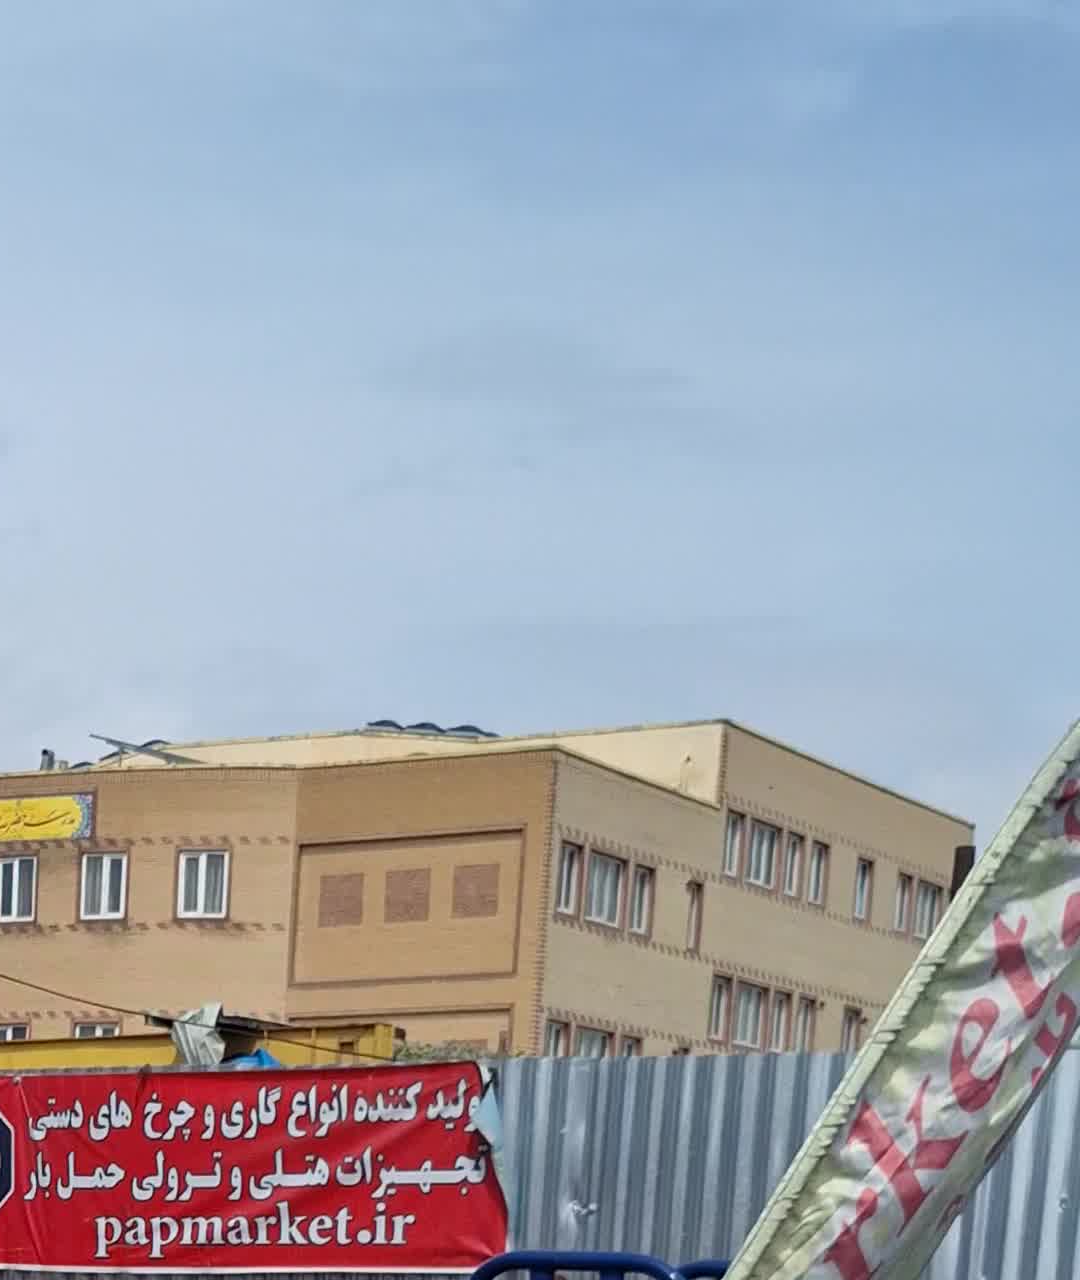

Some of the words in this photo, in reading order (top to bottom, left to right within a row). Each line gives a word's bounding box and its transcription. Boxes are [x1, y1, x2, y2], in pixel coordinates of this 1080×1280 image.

[28, 1096, 84, 1141] دستی
[88, 1090, 133, 1141] های
[143, 1091, 196, 1141] چرخ
[200, 1103, 215, 1140] و
[220, 1083, 281, 1139] گاری
[287, 1083, 348, 1138] انواع
[353, 1080, 423, 1123] کننده
[426, 1077, 482, 1132] ولید
[24, 1151, 51, 1201] بار
[56, 1151, 126, 1200] حمل
[131, 1150, 222, 1201] ترولی
[228, 1165, 243, 1201] و
[248, 1148, 330, 1201] هتلی
[336, 1145, 489, 1199] تجهیزات
[94, 1200, 416, 1259] papmarket.ir
